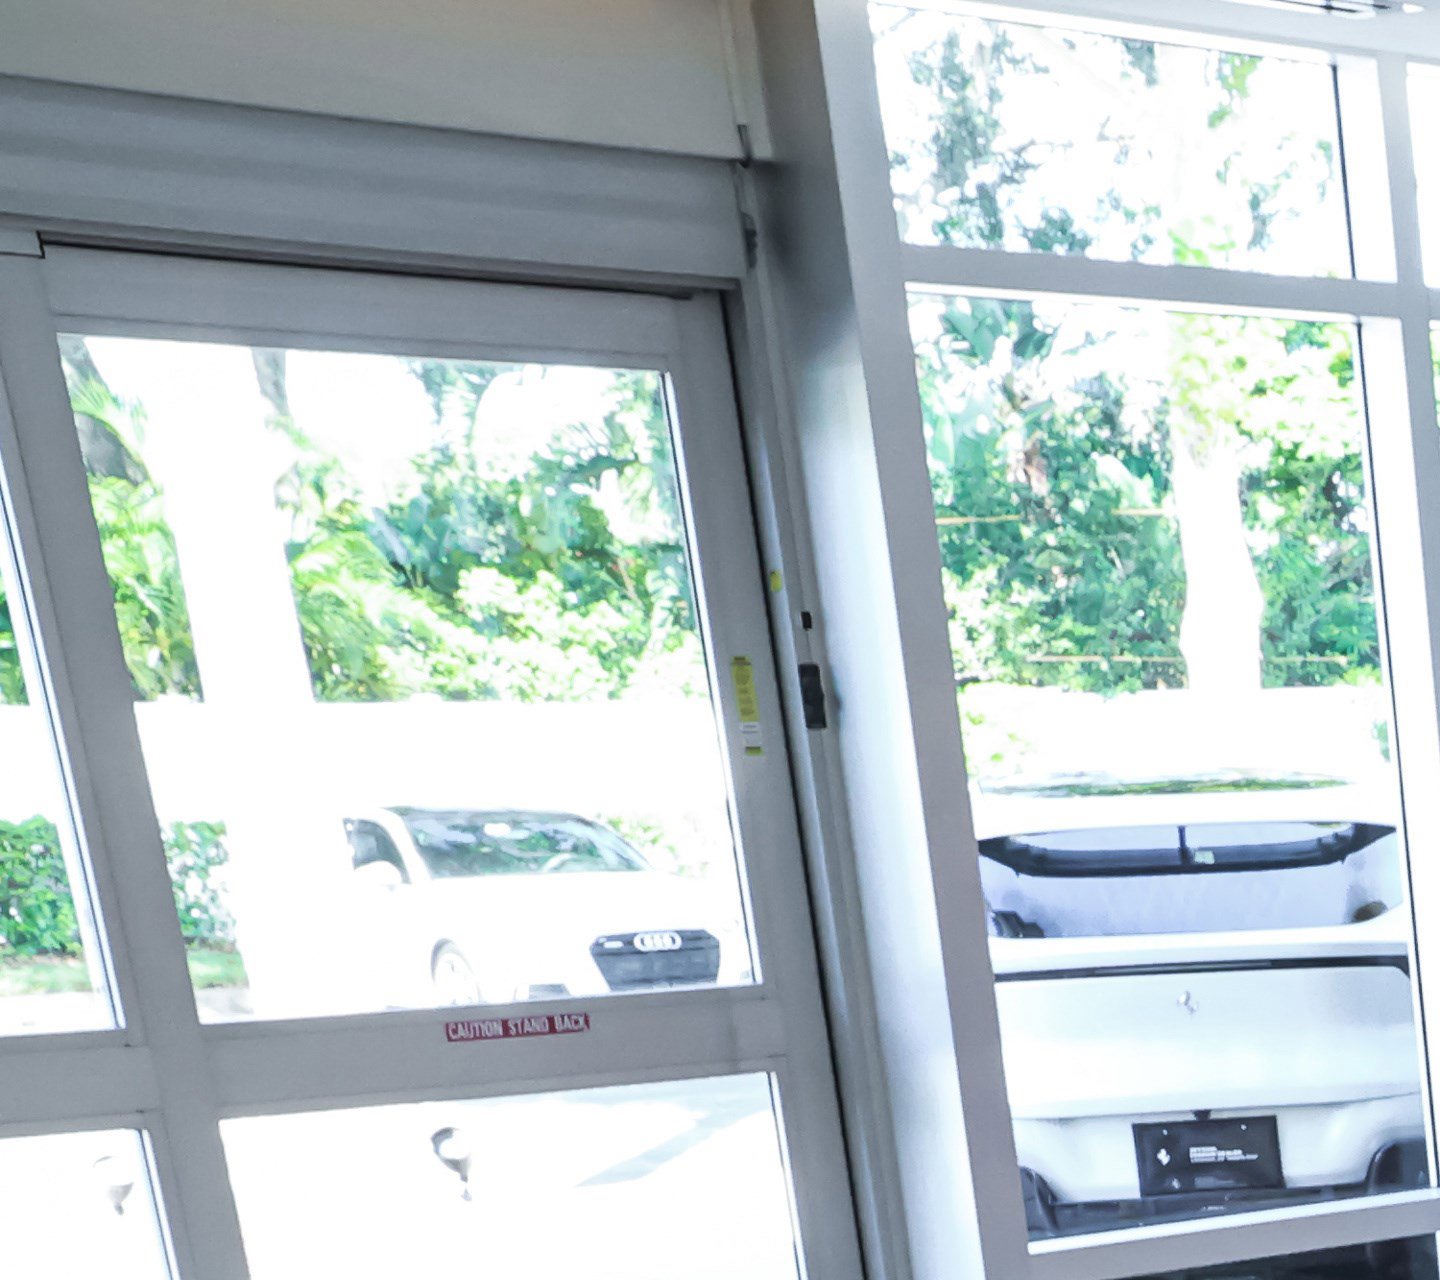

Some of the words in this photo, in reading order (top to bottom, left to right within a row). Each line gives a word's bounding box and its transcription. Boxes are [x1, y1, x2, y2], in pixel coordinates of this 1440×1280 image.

[448, 1020, 503, 1040] CAUTION
[507, 1016, 550, 1036] STAND
[553, 1013, 586, 1033] BACK
